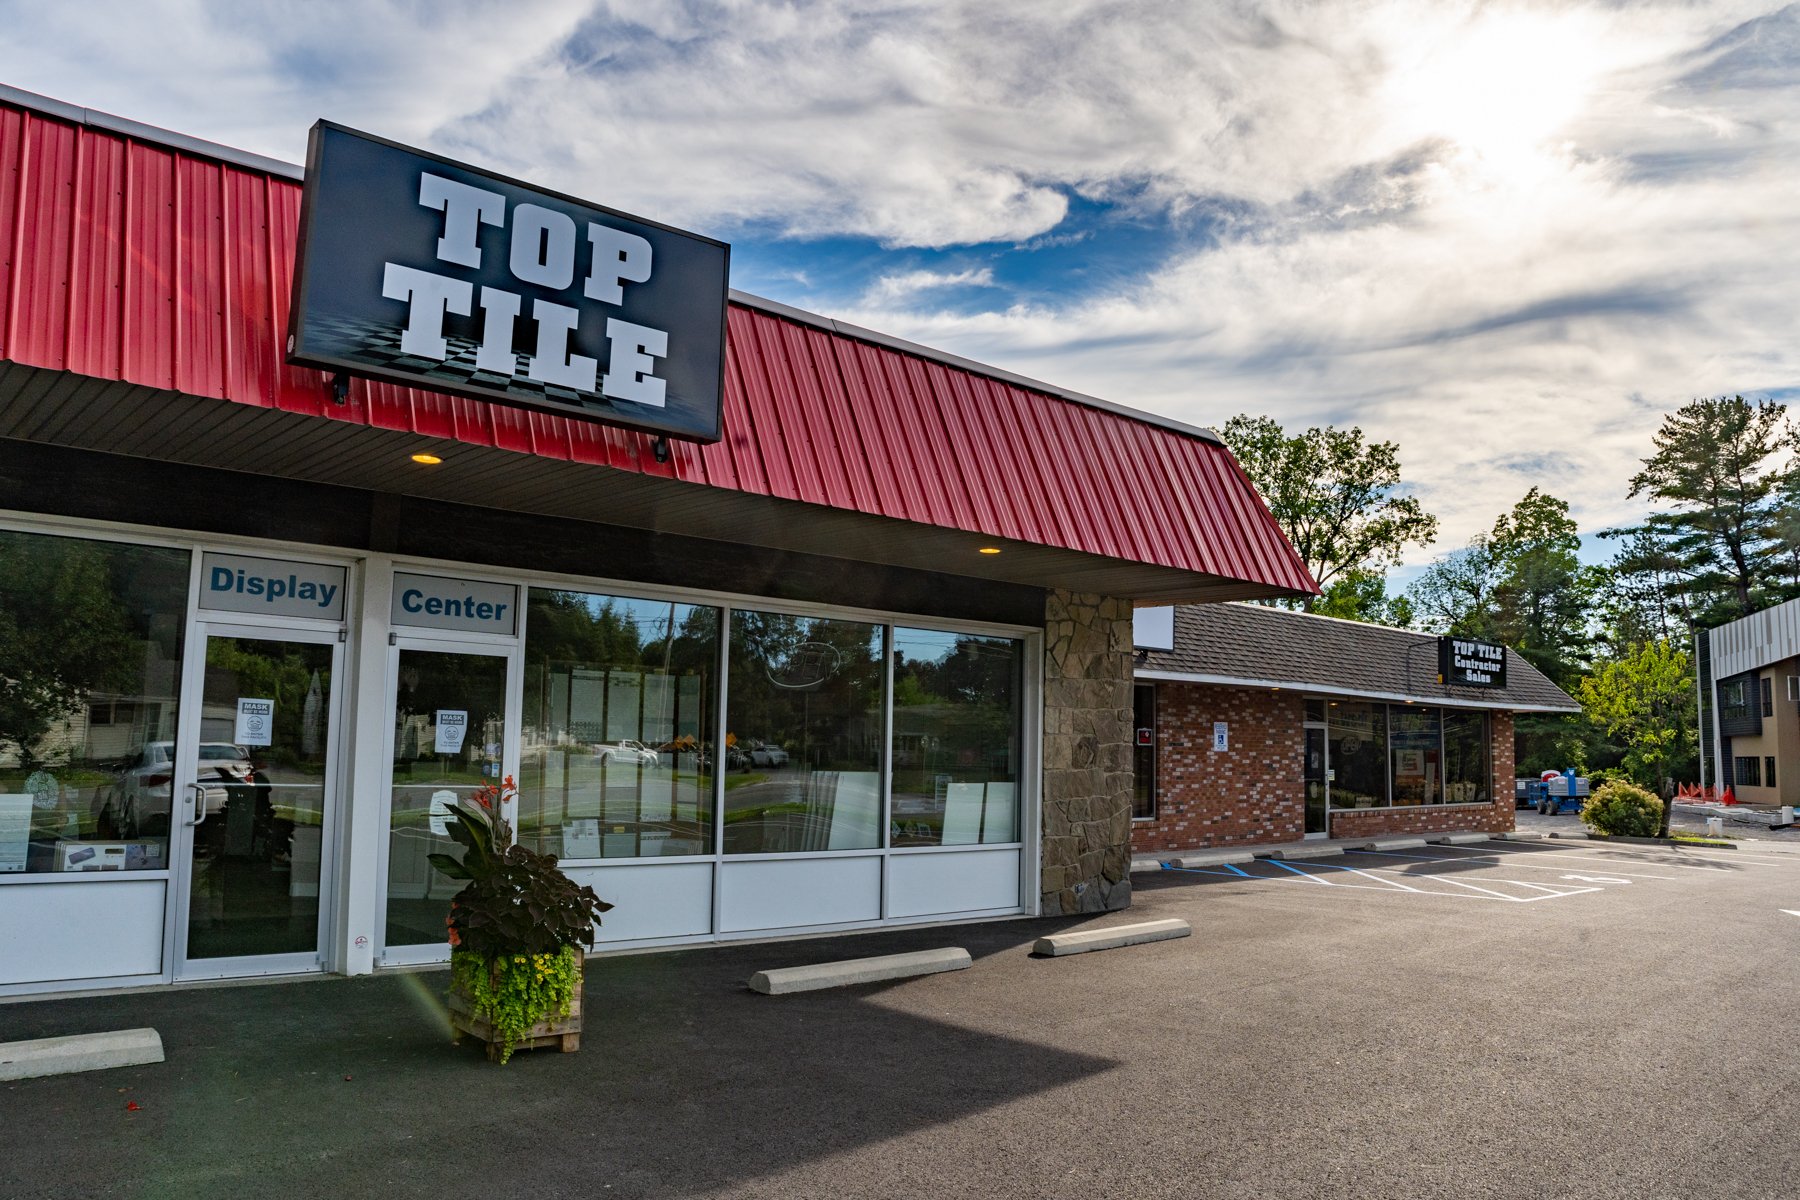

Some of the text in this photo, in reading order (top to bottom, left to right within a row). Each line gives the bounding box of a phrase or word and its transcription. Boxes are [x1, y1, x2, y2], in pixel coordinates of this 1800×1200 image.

[419, 171, 653, 306] TOP
[382, 262, 668, 408] TILE
[210, 566, 507, 621] Display Center
[1453, 641, 1502, 660] TOP TILE
[1455, 655, 1501, 672] Contractor
[1466, 670, 1491, 683] Sales
